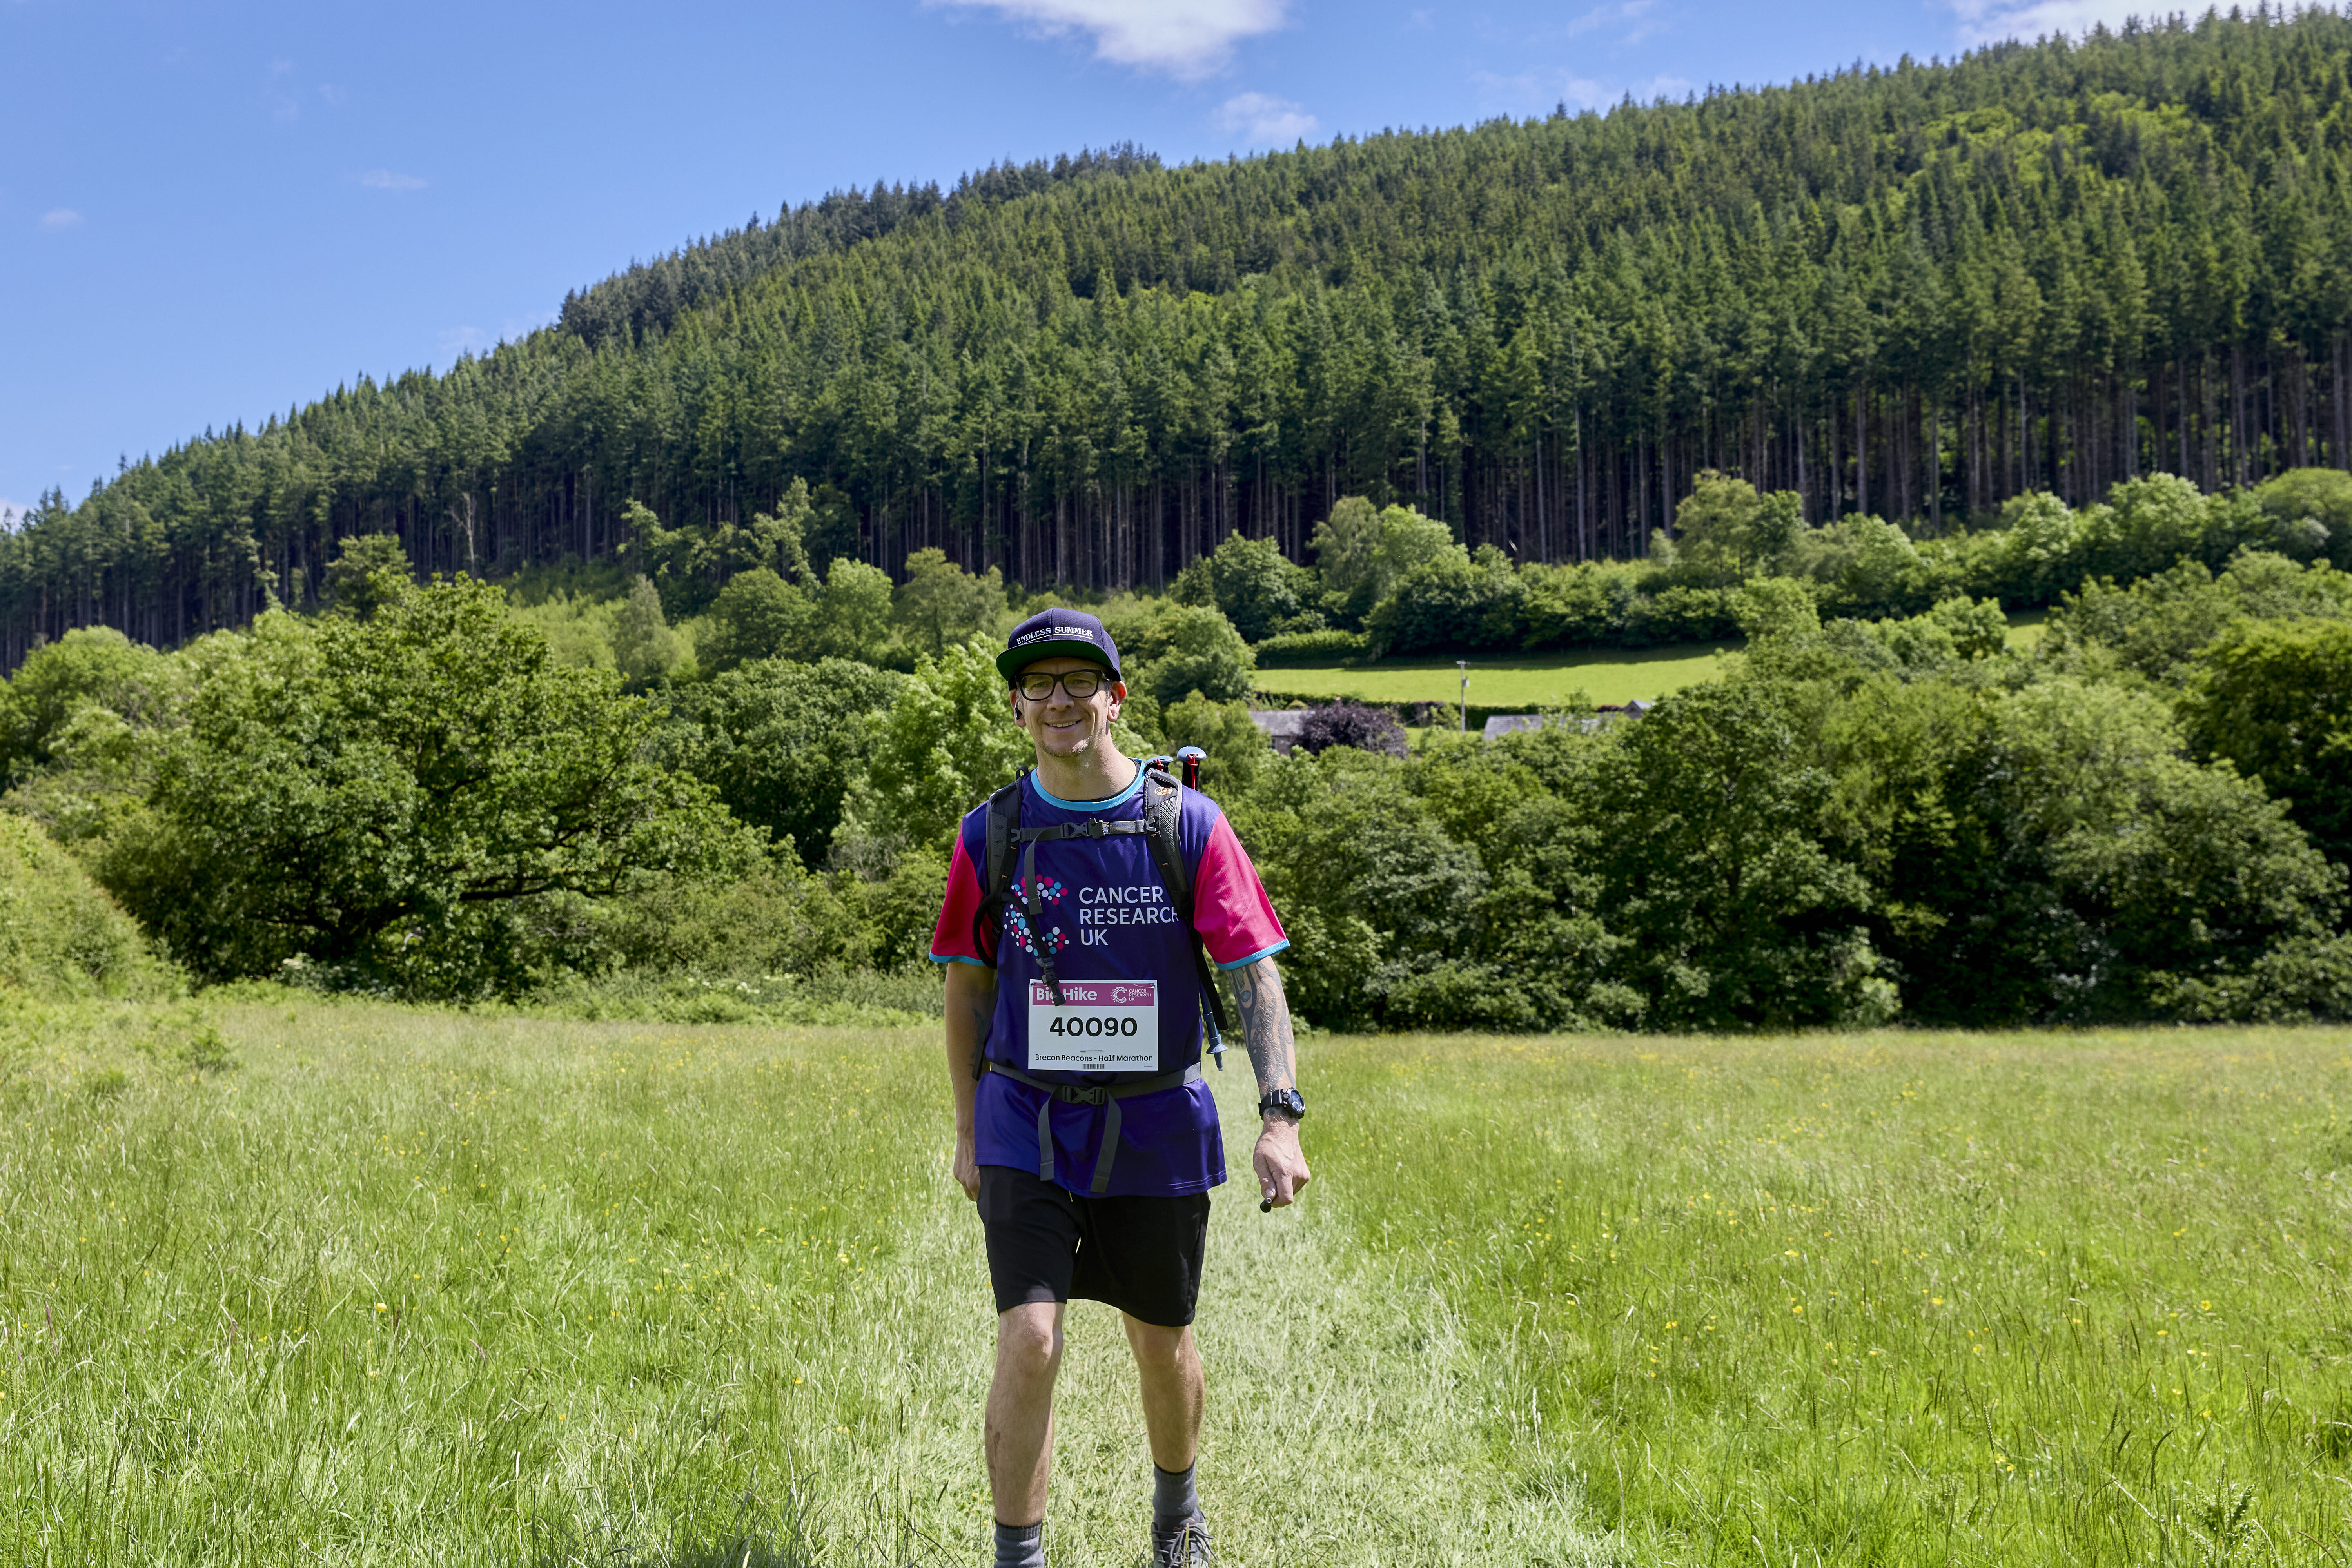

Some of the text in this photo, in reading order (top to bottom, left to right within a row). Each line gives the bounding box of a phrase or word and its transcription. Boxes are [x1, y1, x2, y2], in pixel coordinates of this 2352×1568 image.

[1016, 626, 1093, 644] ENDLESS SUMMER
[1079, 886, 1164, 904] CANCER
[1080, 929, 1109, 946] UK
[1063, 987, 1098, 1001] Hike
[1049, 1017, 1138, 1037] 40090
